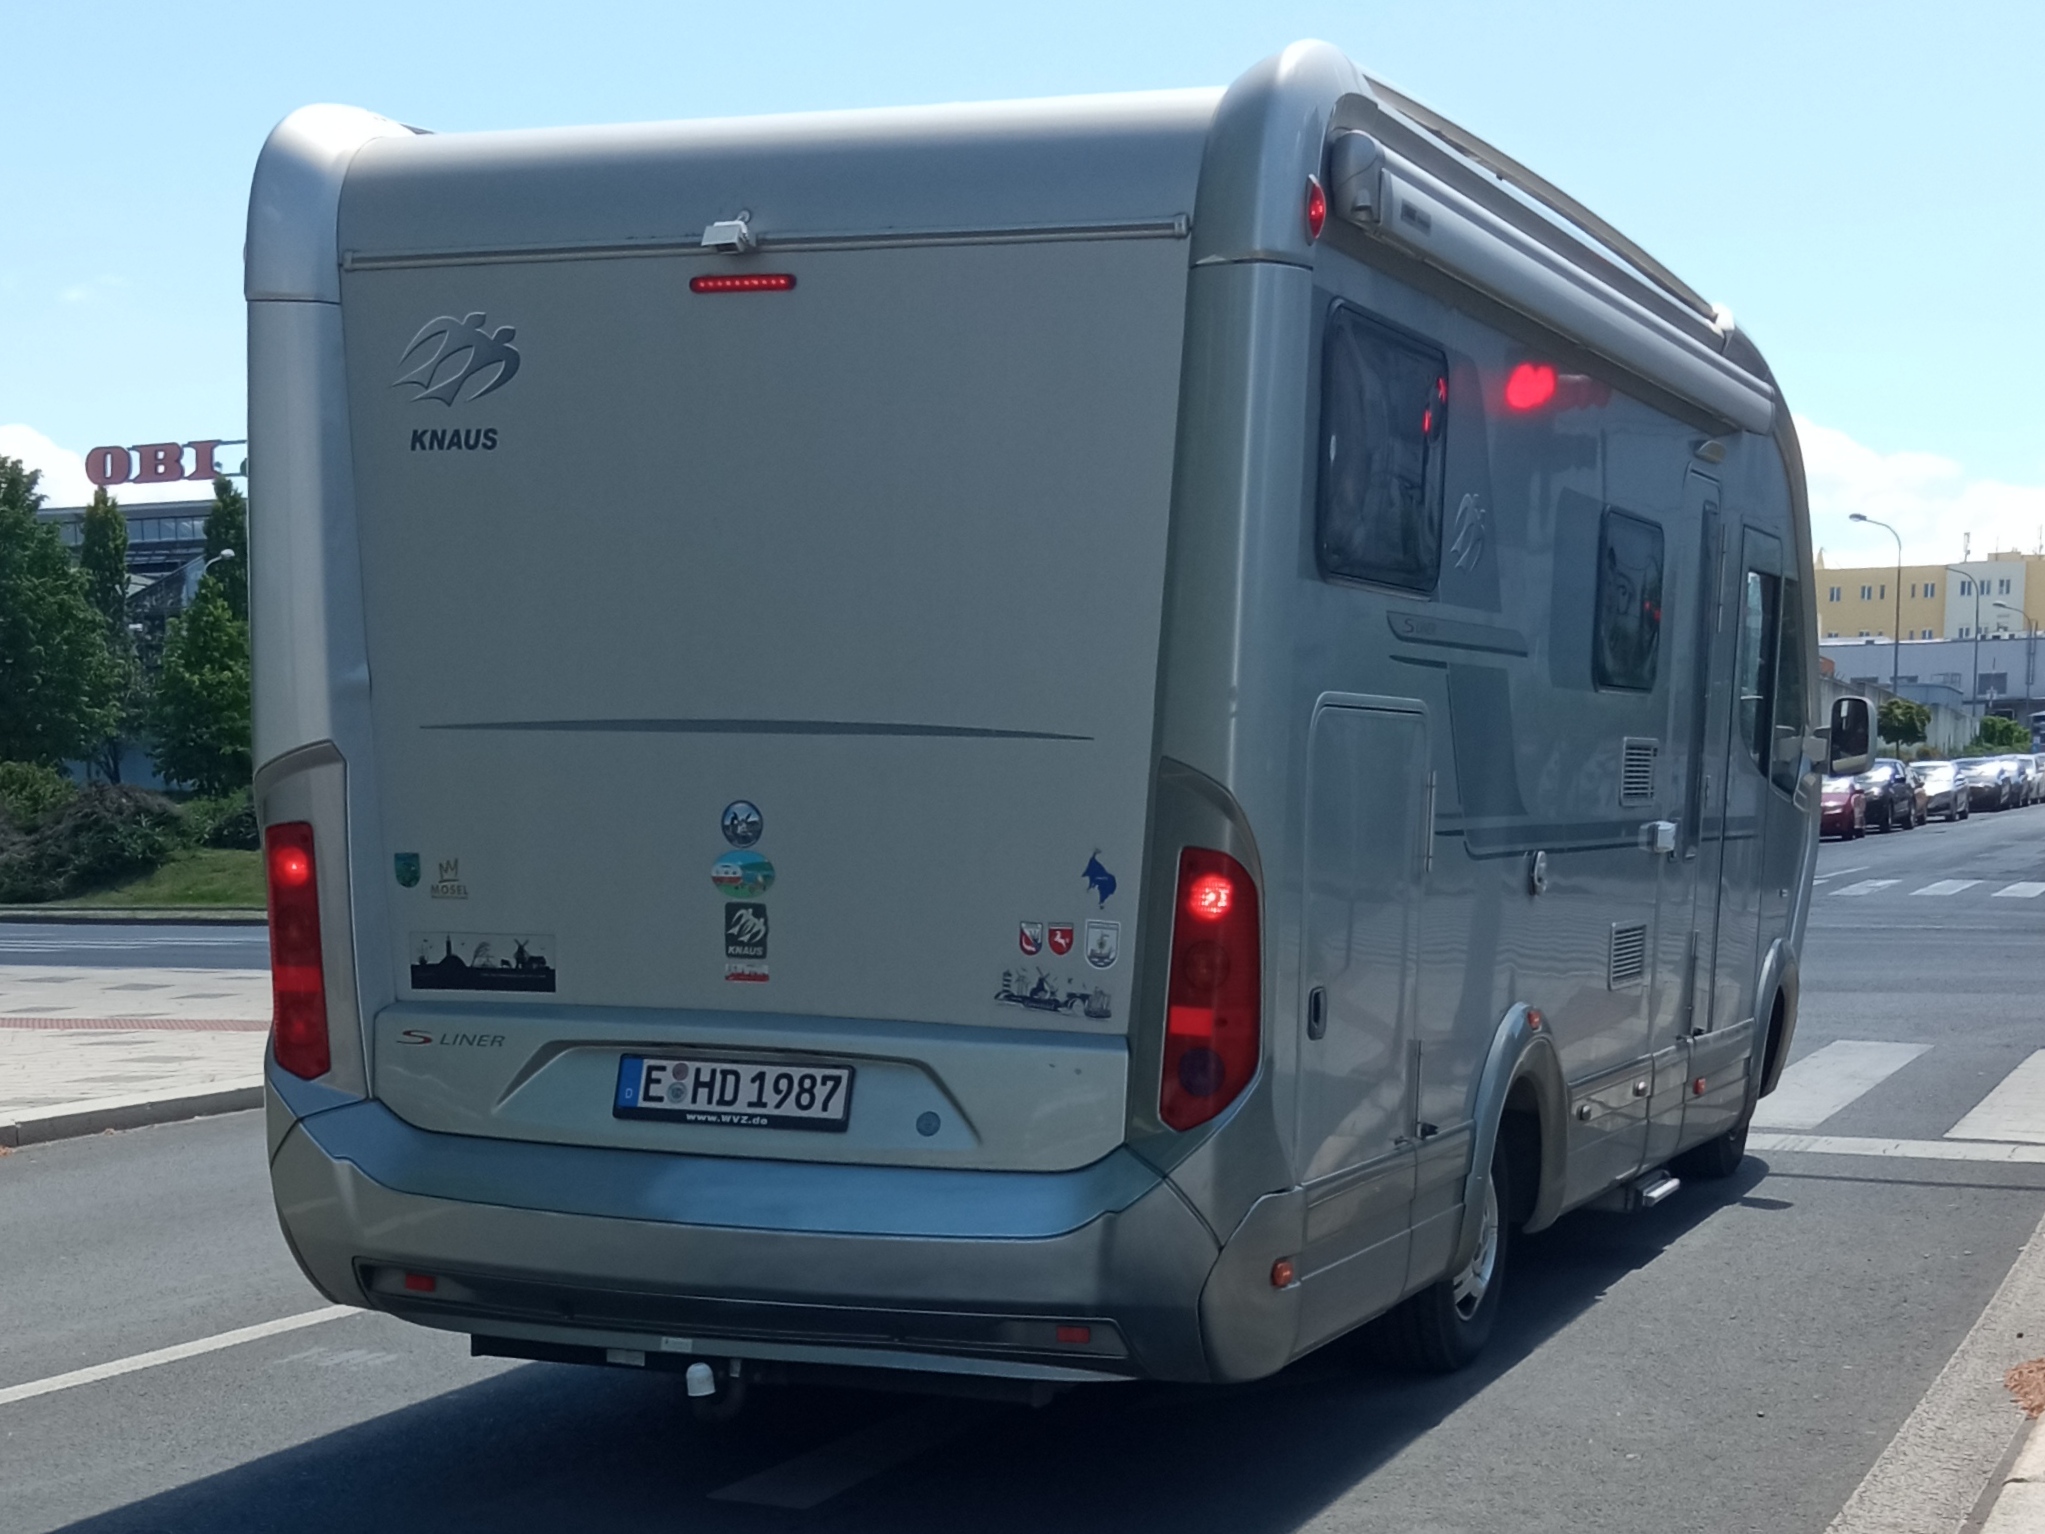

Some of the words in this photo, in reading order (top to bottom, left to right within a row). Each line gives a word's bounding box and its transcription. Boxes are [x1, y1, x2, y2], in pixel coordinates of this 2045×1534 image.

[410, 427, 498, 451] KNAUS
[85, 439, 222, 485] OBI
[430, 884, 468, 896] MOSEL
[728, 945, 763, 955] KNAUS
[439, 1033, 506, 1048] LINER
[642, 1064, 668, 1103] E
[690, 1067, 742, 1107] HD
[746, 1070, 843, 1113] 1987
